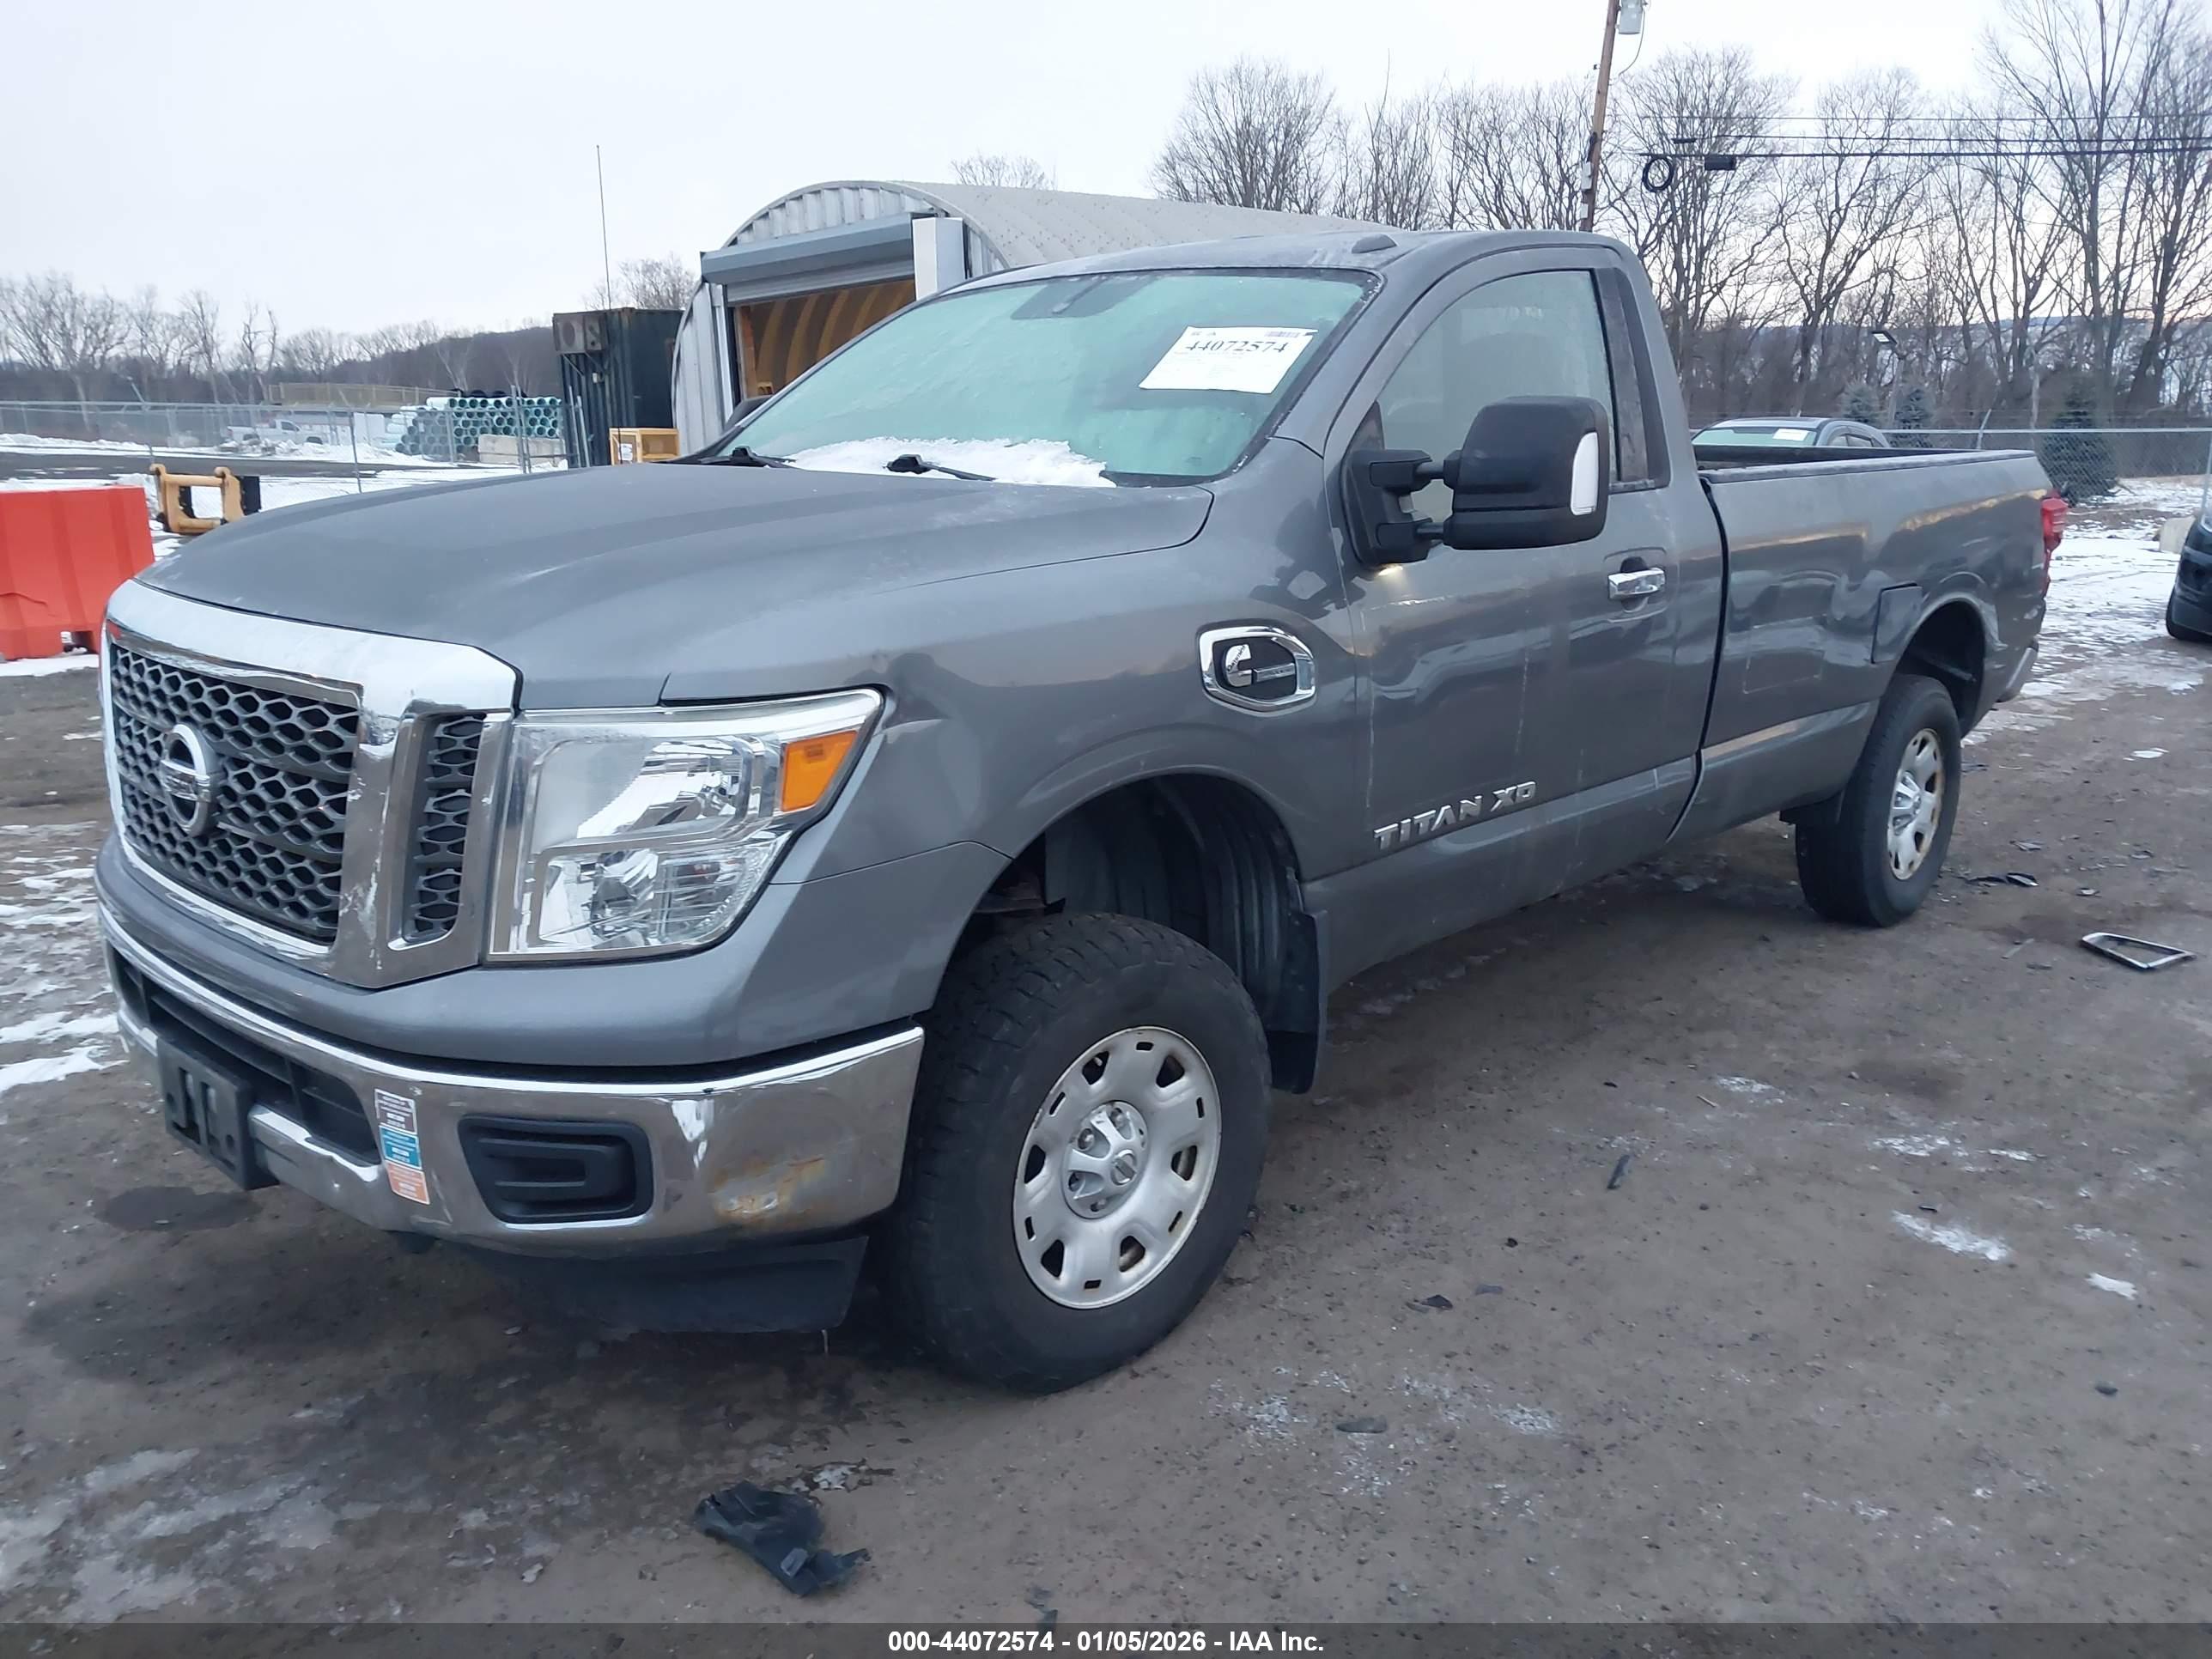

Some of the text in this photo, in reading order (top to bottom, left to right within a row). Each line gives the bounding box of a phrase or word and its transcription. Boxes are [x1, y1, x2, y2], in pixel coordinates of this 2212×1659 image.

[1186, 340, 1289, 352] 44072574
[1373, 781, 1537, 850] TITAN XD
